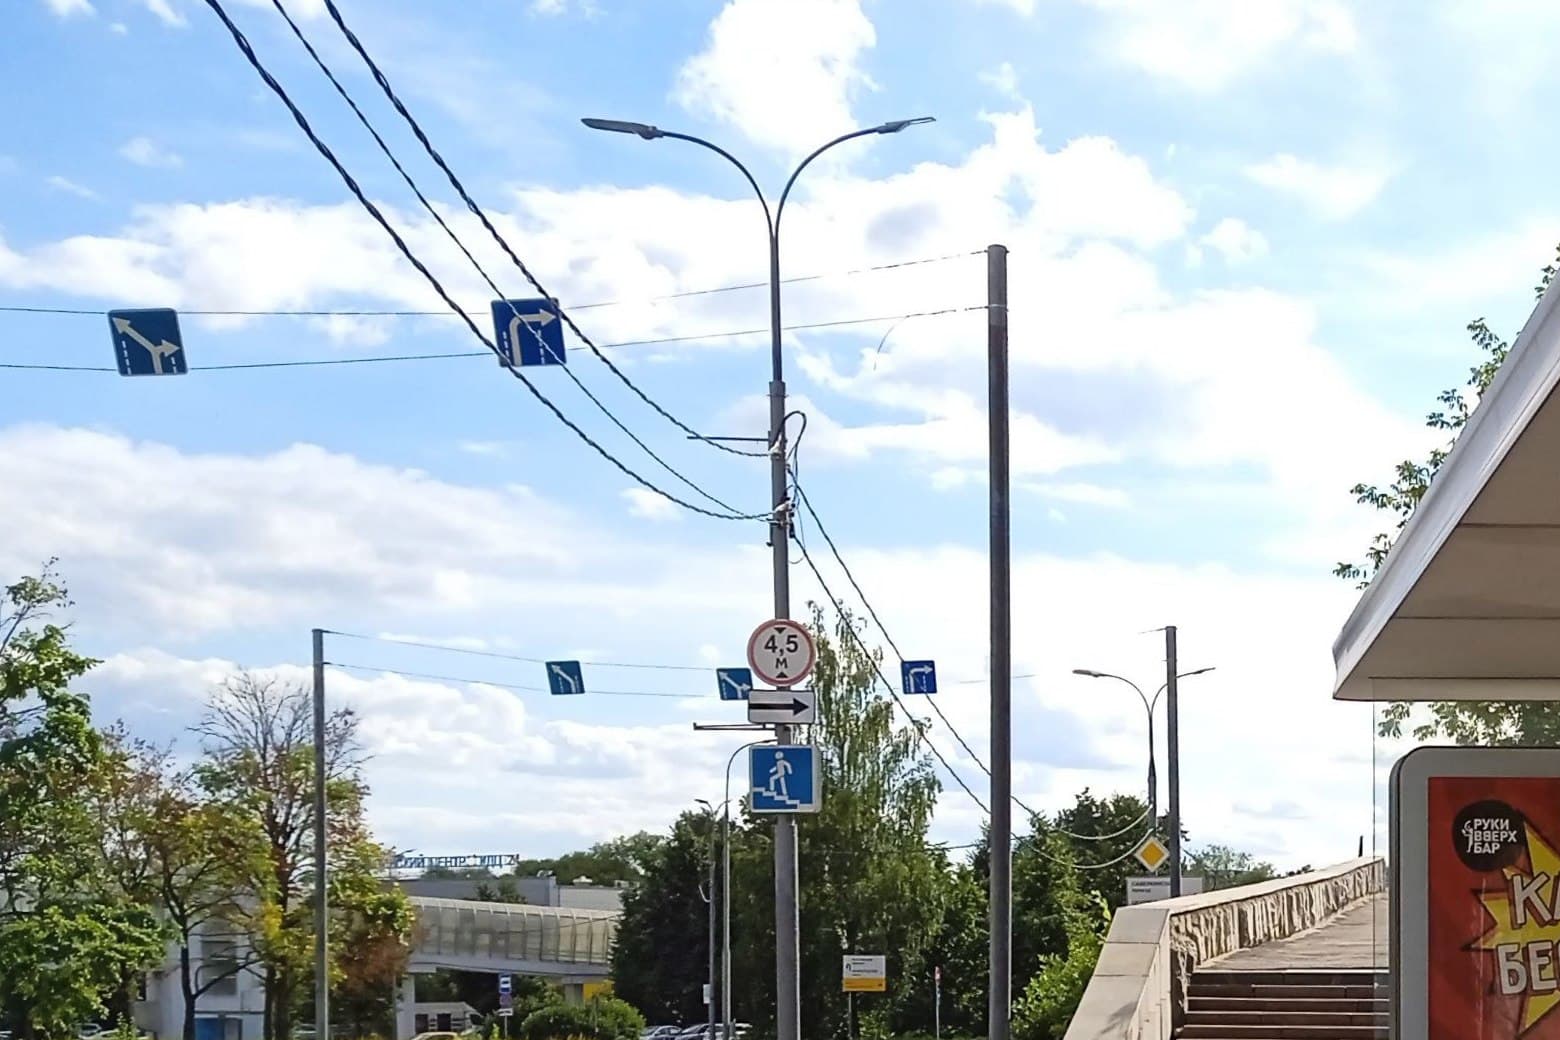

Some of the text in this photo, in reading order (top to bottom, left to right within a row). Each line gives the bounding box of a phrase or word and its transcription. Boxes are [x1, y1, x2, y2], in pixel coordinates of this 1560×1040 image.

[764, 634, 799, 656] 4,5
[1473, 818, 1510, 831] РУКИ
[1474, 830, 1518, 843] ВВЕРХ
[1473, 842, 1501, 854] БАР
